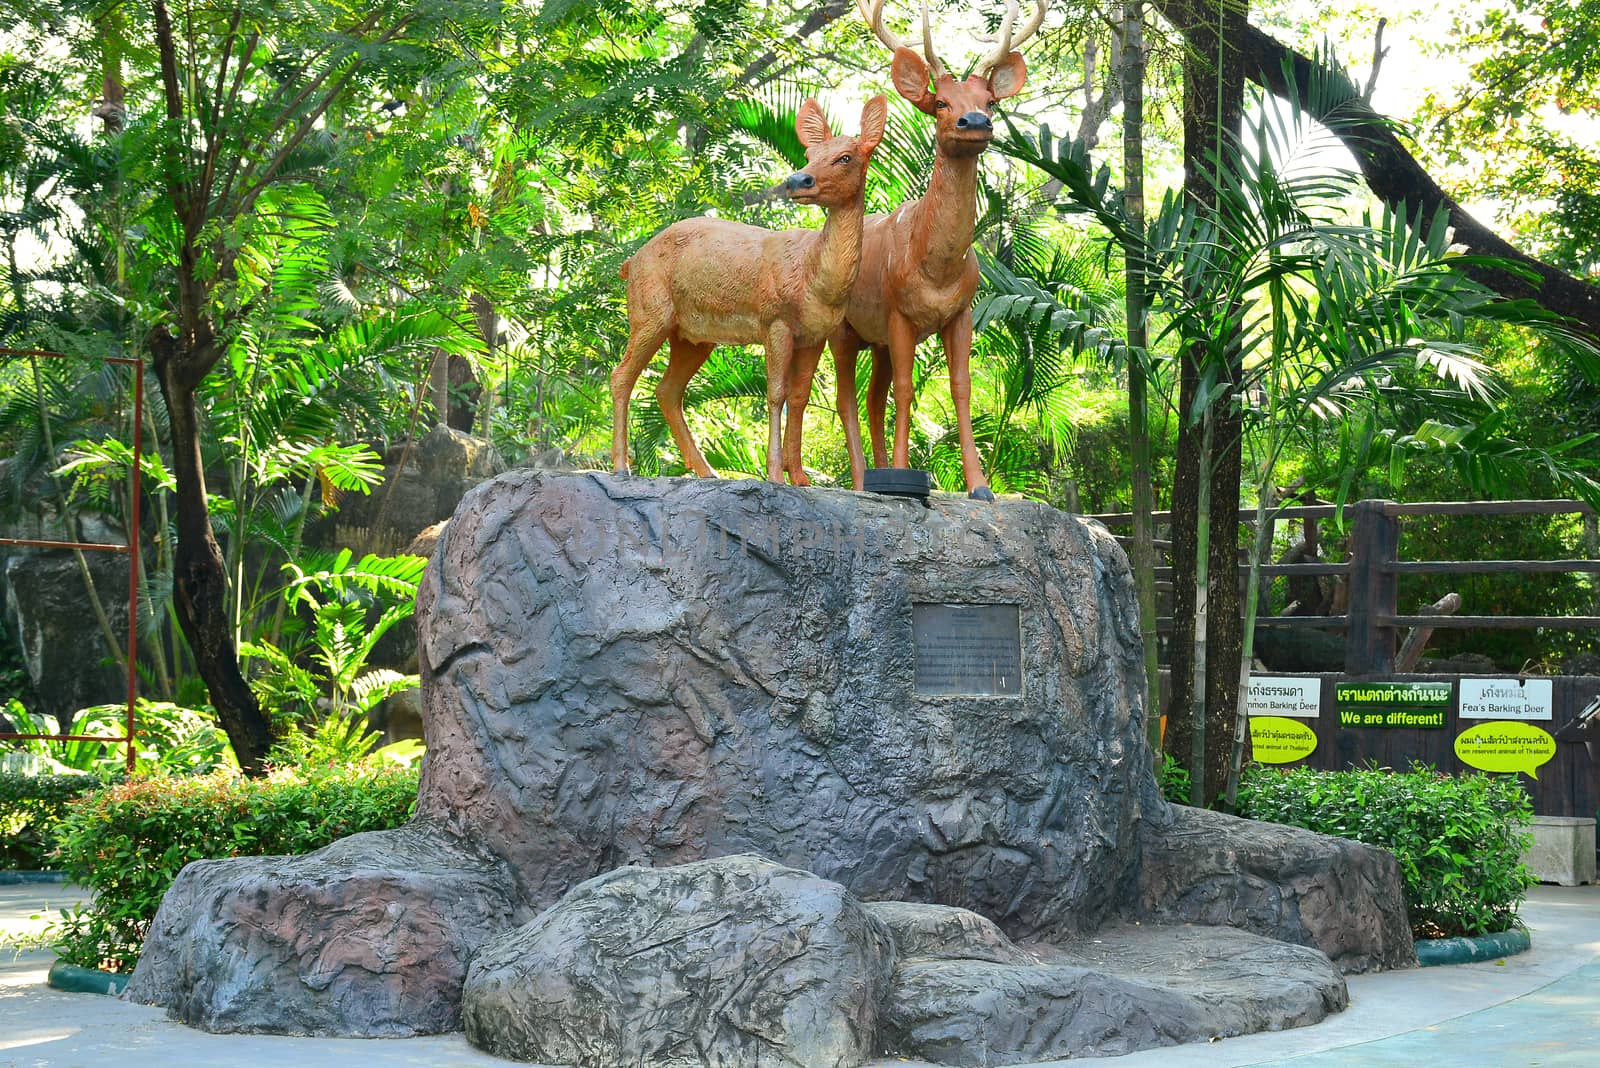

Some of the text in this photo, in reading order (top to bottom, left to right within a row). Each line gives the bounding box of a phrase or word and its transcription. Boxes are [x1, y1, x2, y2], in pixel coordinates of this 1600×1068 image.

[1337, 685, 1448, 702] เราแตกต่างกันนะ
[1270, 701, 1298, 711] Barking
[1300, 702, 1318, 710] Deer
[1462, 703, 1544, 714] Fea's Barking Deer
[1340, 711, 1443, 725] We are different!
